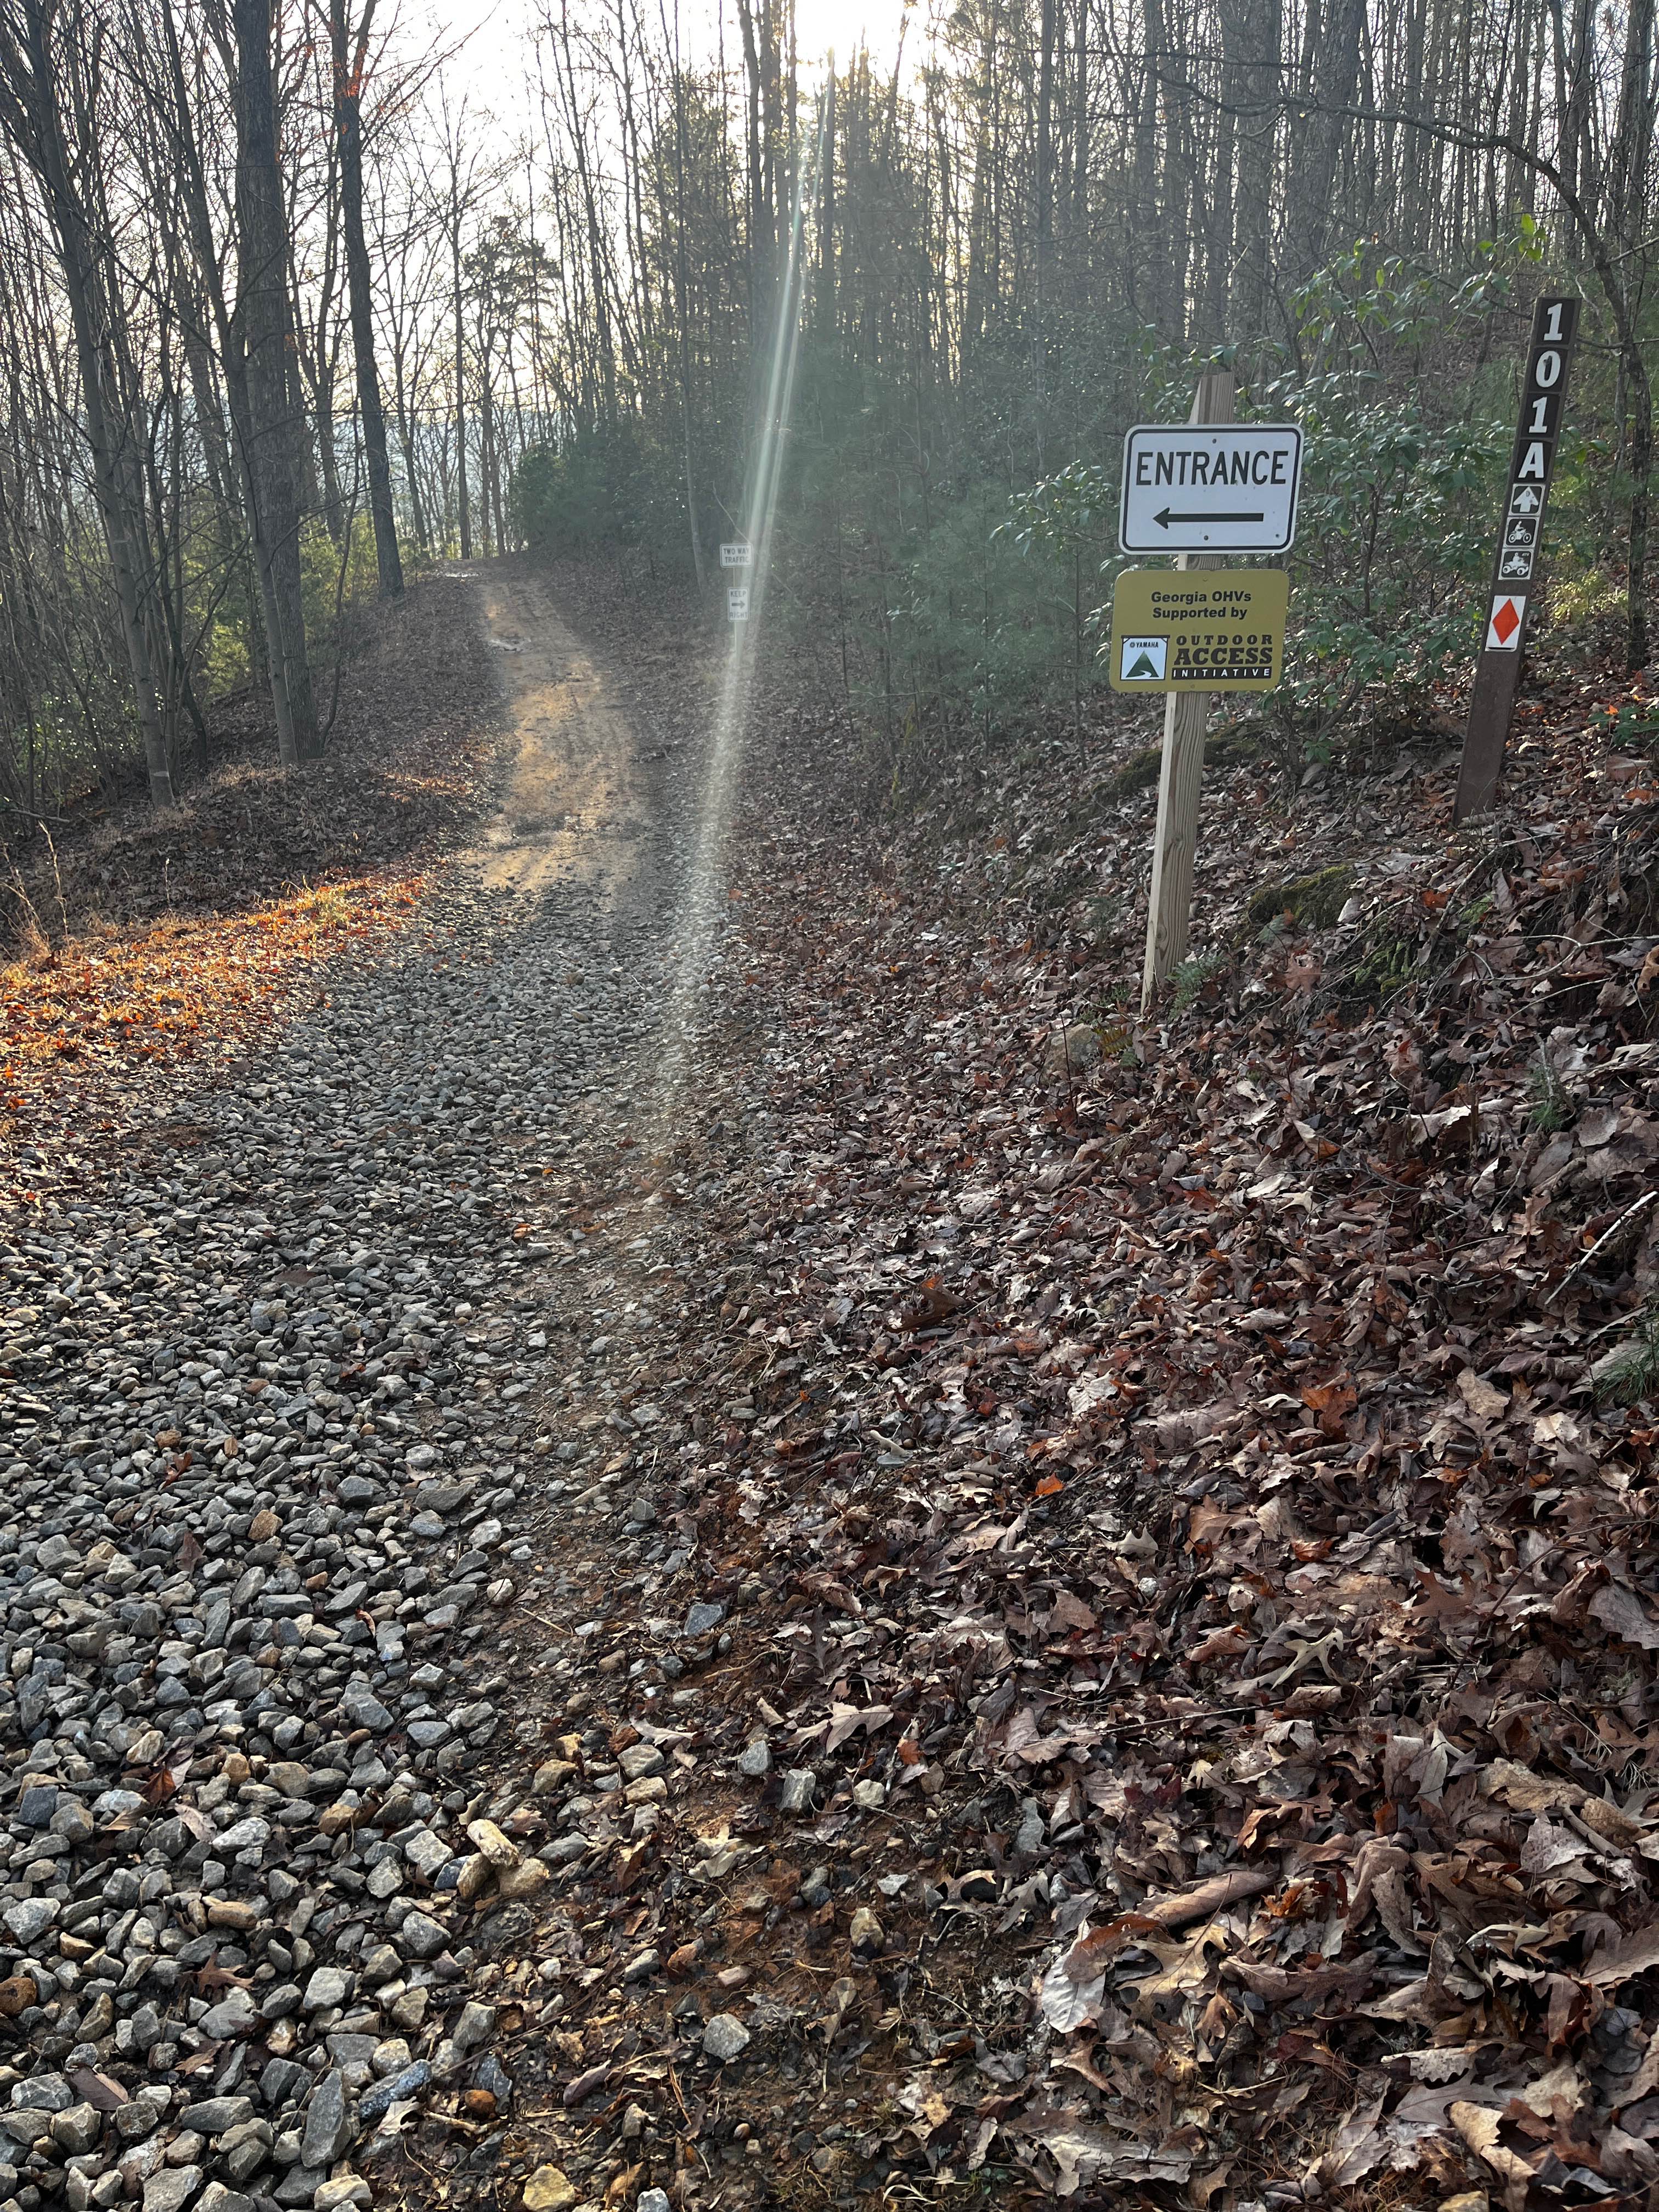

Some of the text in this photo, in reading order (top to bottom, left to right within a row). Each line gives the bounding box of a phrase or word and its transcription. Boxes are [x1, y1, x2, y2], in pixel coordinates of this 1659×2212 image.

[1518, 303, 1563, 478] 101A
[1136, 450, 1289, 486] ENTRANCE
[1151, 590, 1251, 604] Georgia OHVs
[1153, 607, 1248, 620] Supported by
[1176, 635, 1273, 646] OUTDOOR
[1173, 647, 1273, 665] ACCESS
[1173, 668, 1270, 678] INITIATIVE
